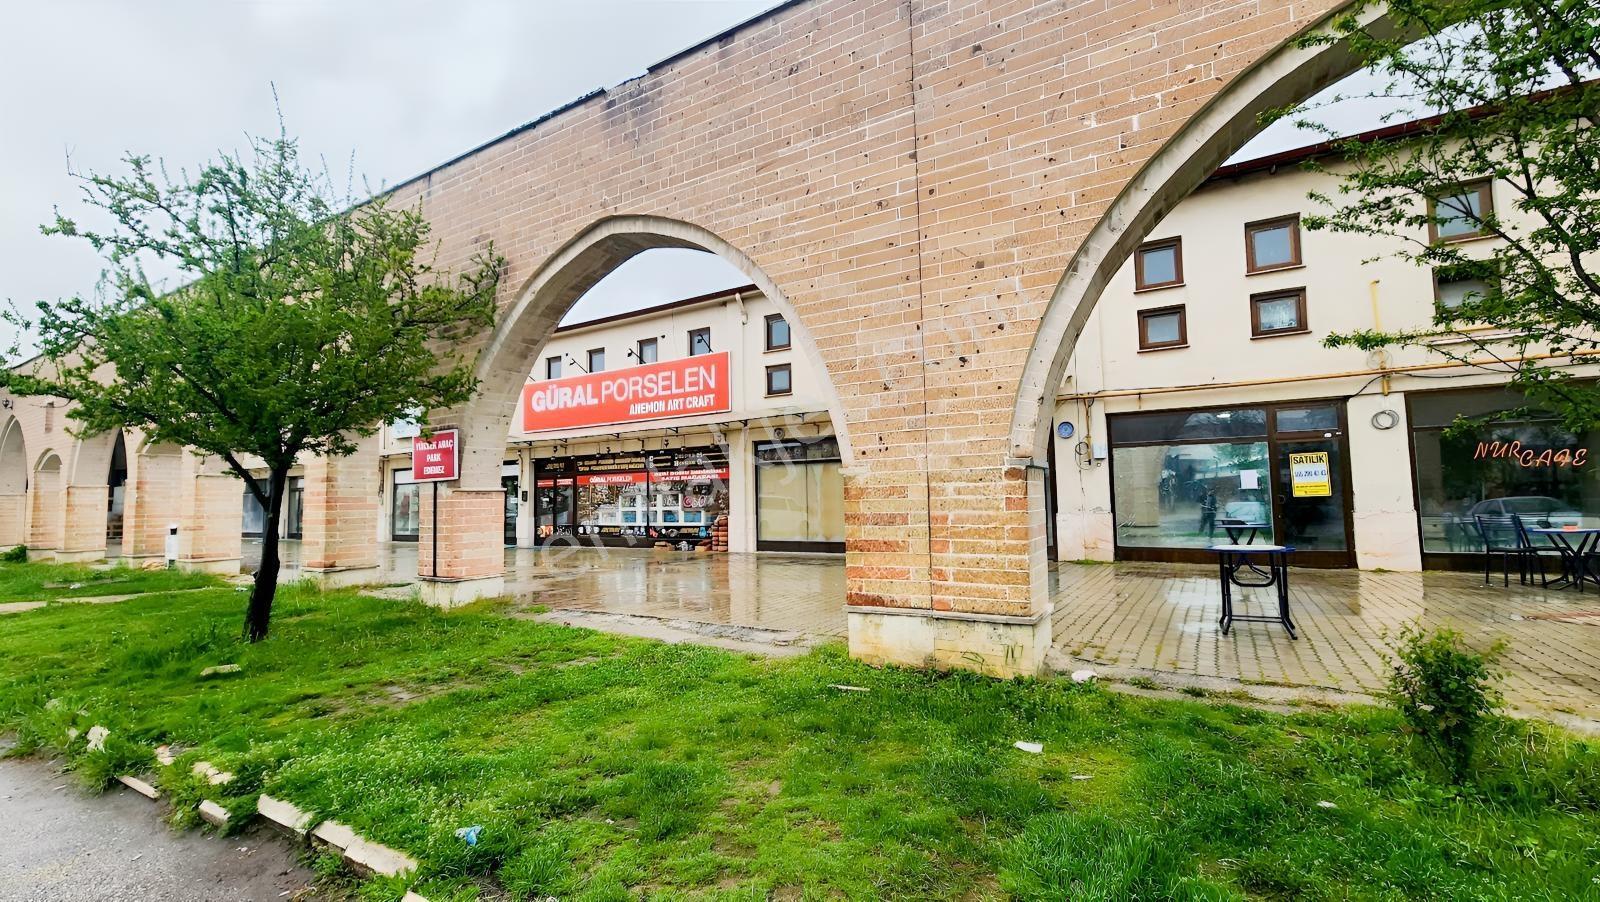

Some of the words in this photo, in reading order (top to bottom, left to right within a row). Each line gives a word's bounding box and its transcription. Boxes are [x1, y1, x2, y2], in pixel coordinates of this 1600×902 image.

[531, 384, 598, 413] GÜRAL
[601, 364, 715, 404] PORSELEN
[629, 399, 665, 416] ANEMON
[667, 397, 684, 411] ART
[685, 394, 715, 409] CRAFT
[426, 453, 441, 462] PARK
[1473, 440, 1520, 460] NUR
[1292, 454, 1325, 465] SATILIK
[424, 465, 444, 475] EDEMEZ
